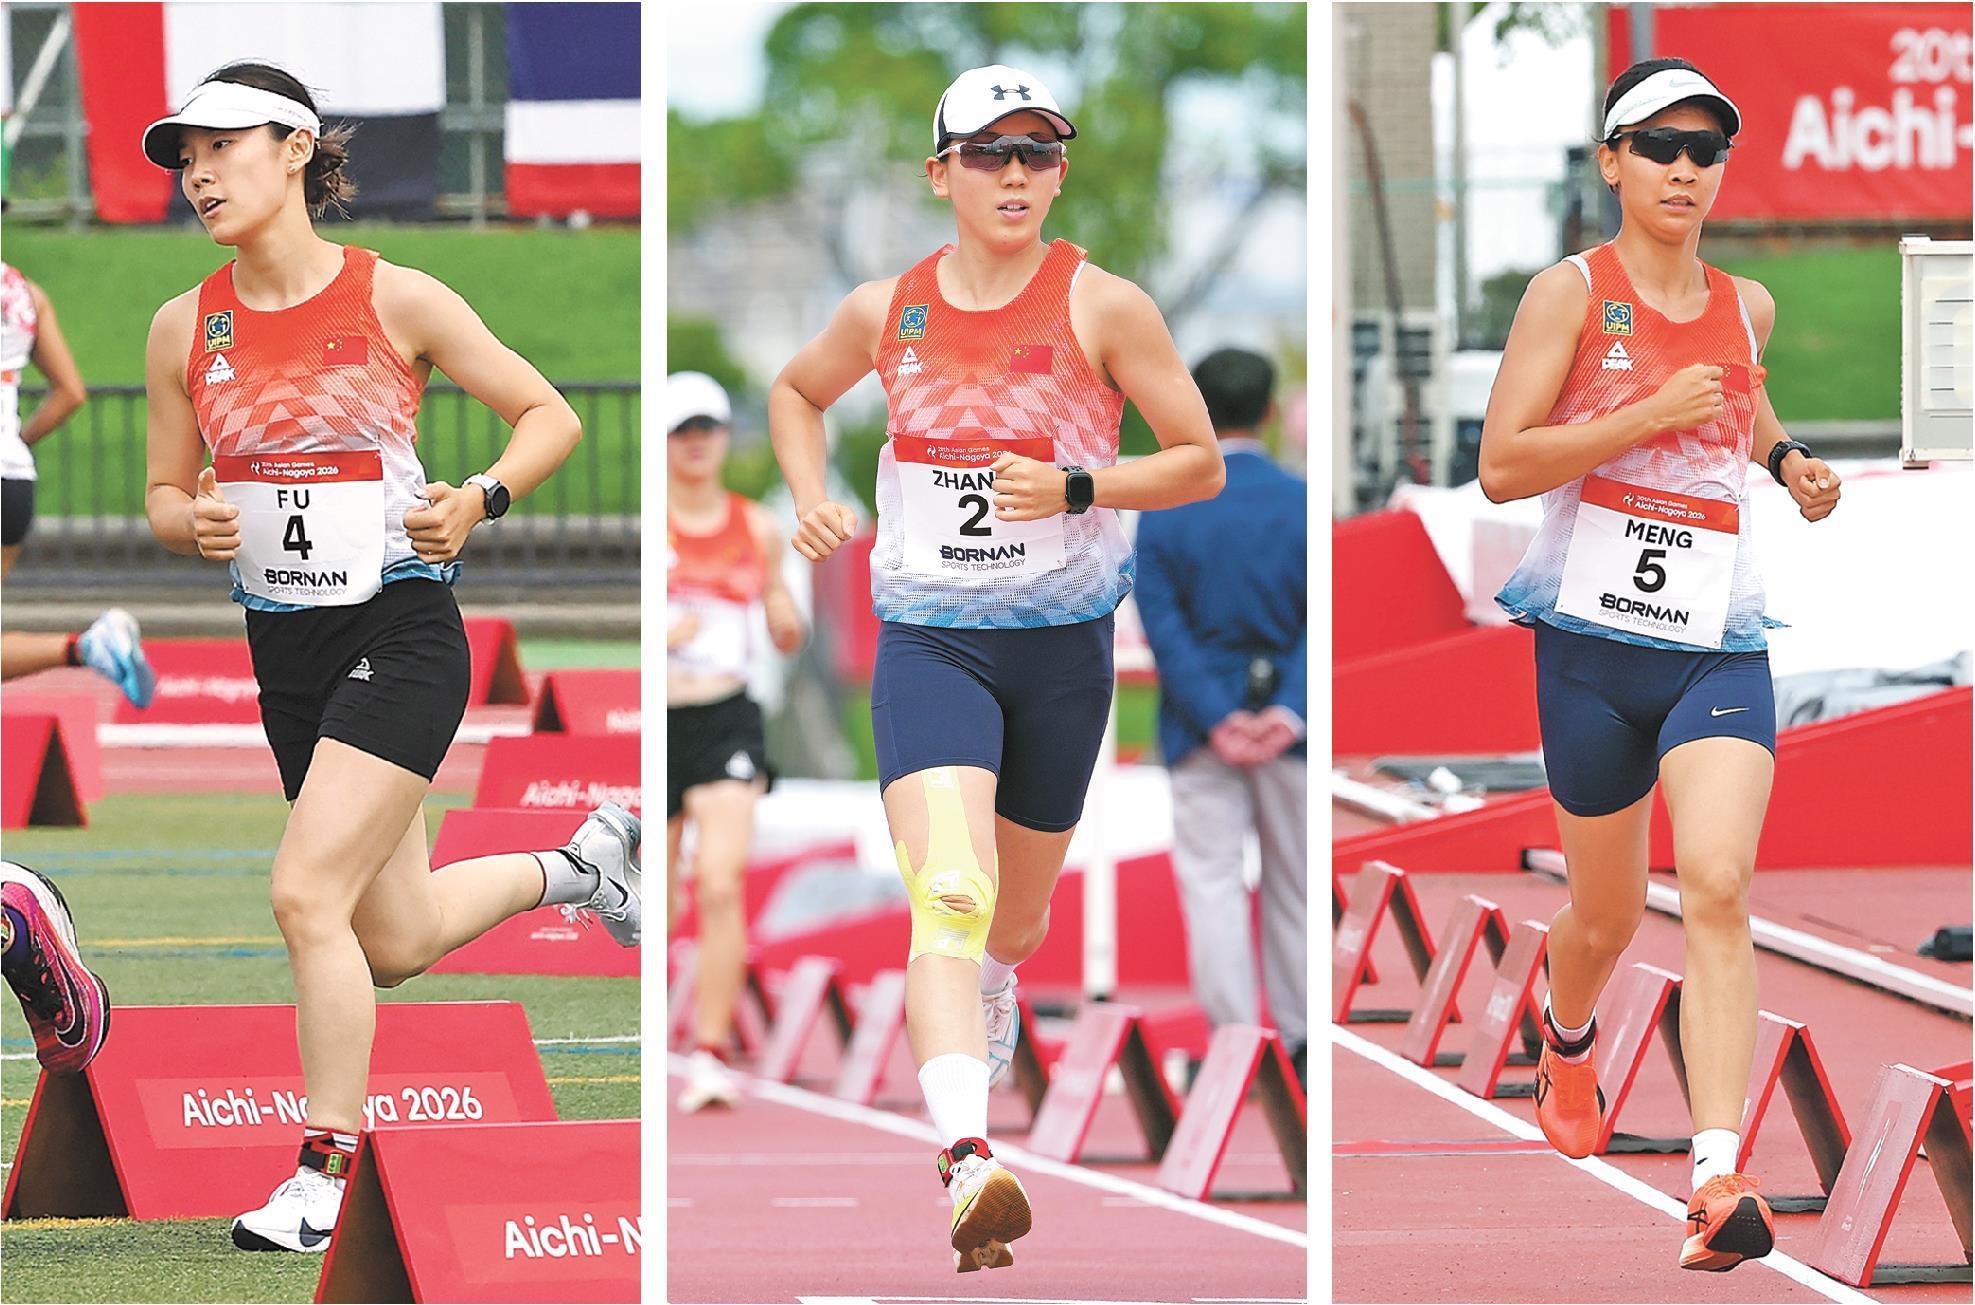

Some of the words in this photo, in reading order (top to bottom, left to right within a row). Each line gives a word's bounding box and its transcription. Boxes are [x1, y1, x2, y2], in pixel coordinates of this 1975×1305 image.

[940, 453, 990, 463] Aichi-Nagoya
[263, 468, 315, 478] Aichi-Nagoya
[317, 466, 339, 475] 2026
[932, 470, 995, 491] ZHAN
[277, 489, 310, 509] FU
[958, 494, 992, 536] 2
[1634, 501, 1686, 519] Aichi-Nagoya
[1687, 510, 1706, 520] 2026
[283, 515, 313, 560] 4
[1624, 519, 1693, 549] MENG
[939, 543, 1026, 562] BORNAN
[942, 561, 968, 571] SPORTS
[971, 558, 1026, 571] TECHNOLOGY
[1632, 549, 1667, 593] 5
[264, 569, 347, 587] BORNAN
[295, 586, 347, 596] TECHNOLOGY
[1599, 592, 1690, 626] BORNAN
[1599, 608, 1631, 623] SPORTS
[1632, 615, 1687, 634] TECHNOLOGY
[182, 1086, 399, 1129] Aichi-Nya
[401, 1086, 483, 1122] 2026
[505, 1212, 641, 1259] Aichi-N
